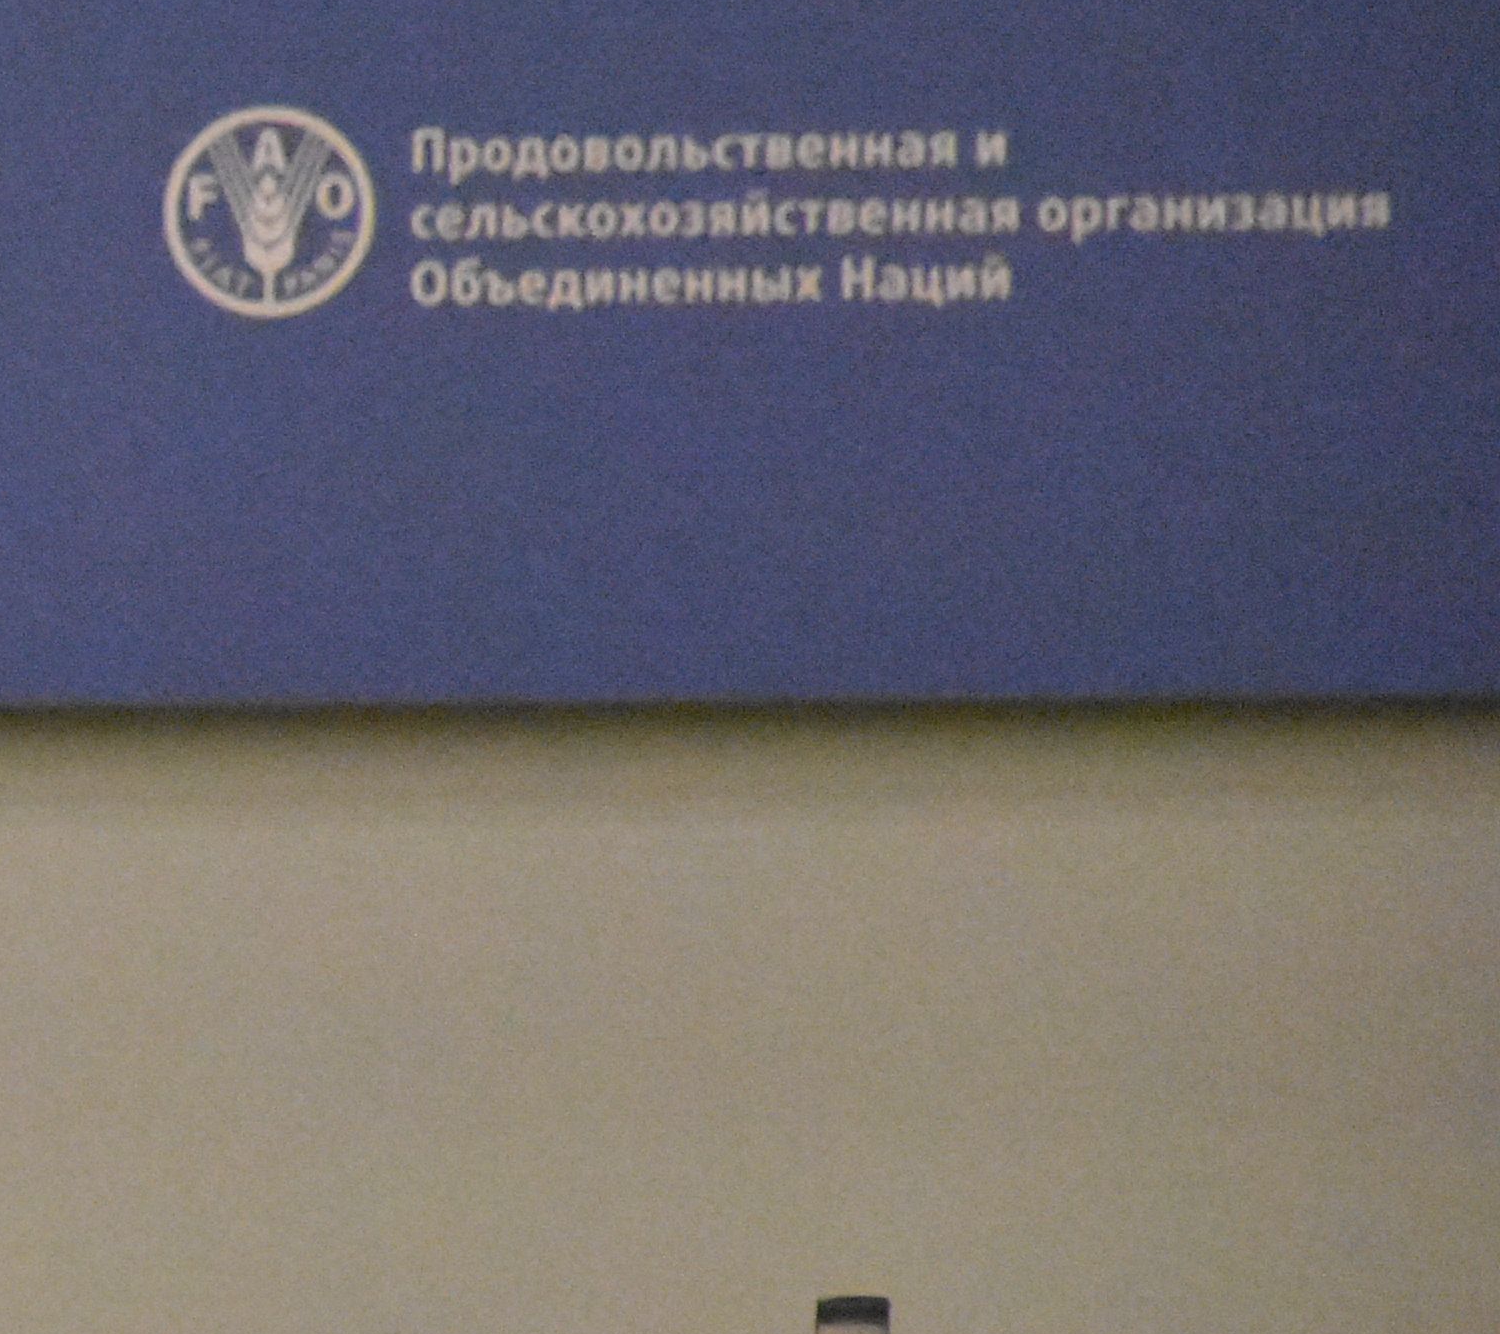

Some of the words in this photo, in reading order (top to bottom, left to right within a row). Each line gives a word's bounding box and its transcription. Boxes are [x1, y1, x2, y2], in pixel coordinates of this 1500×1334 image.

[411, 127, 957, 185] Продовольственная
[975, 131, 1008, 166] и
[410, 191, 1020, 240] сельскохозяйственная
[1037, 193, 1391, 244] организация
[410, 258, 821, 310] Объединенных
[841, 255, 1011, 307] Наций
